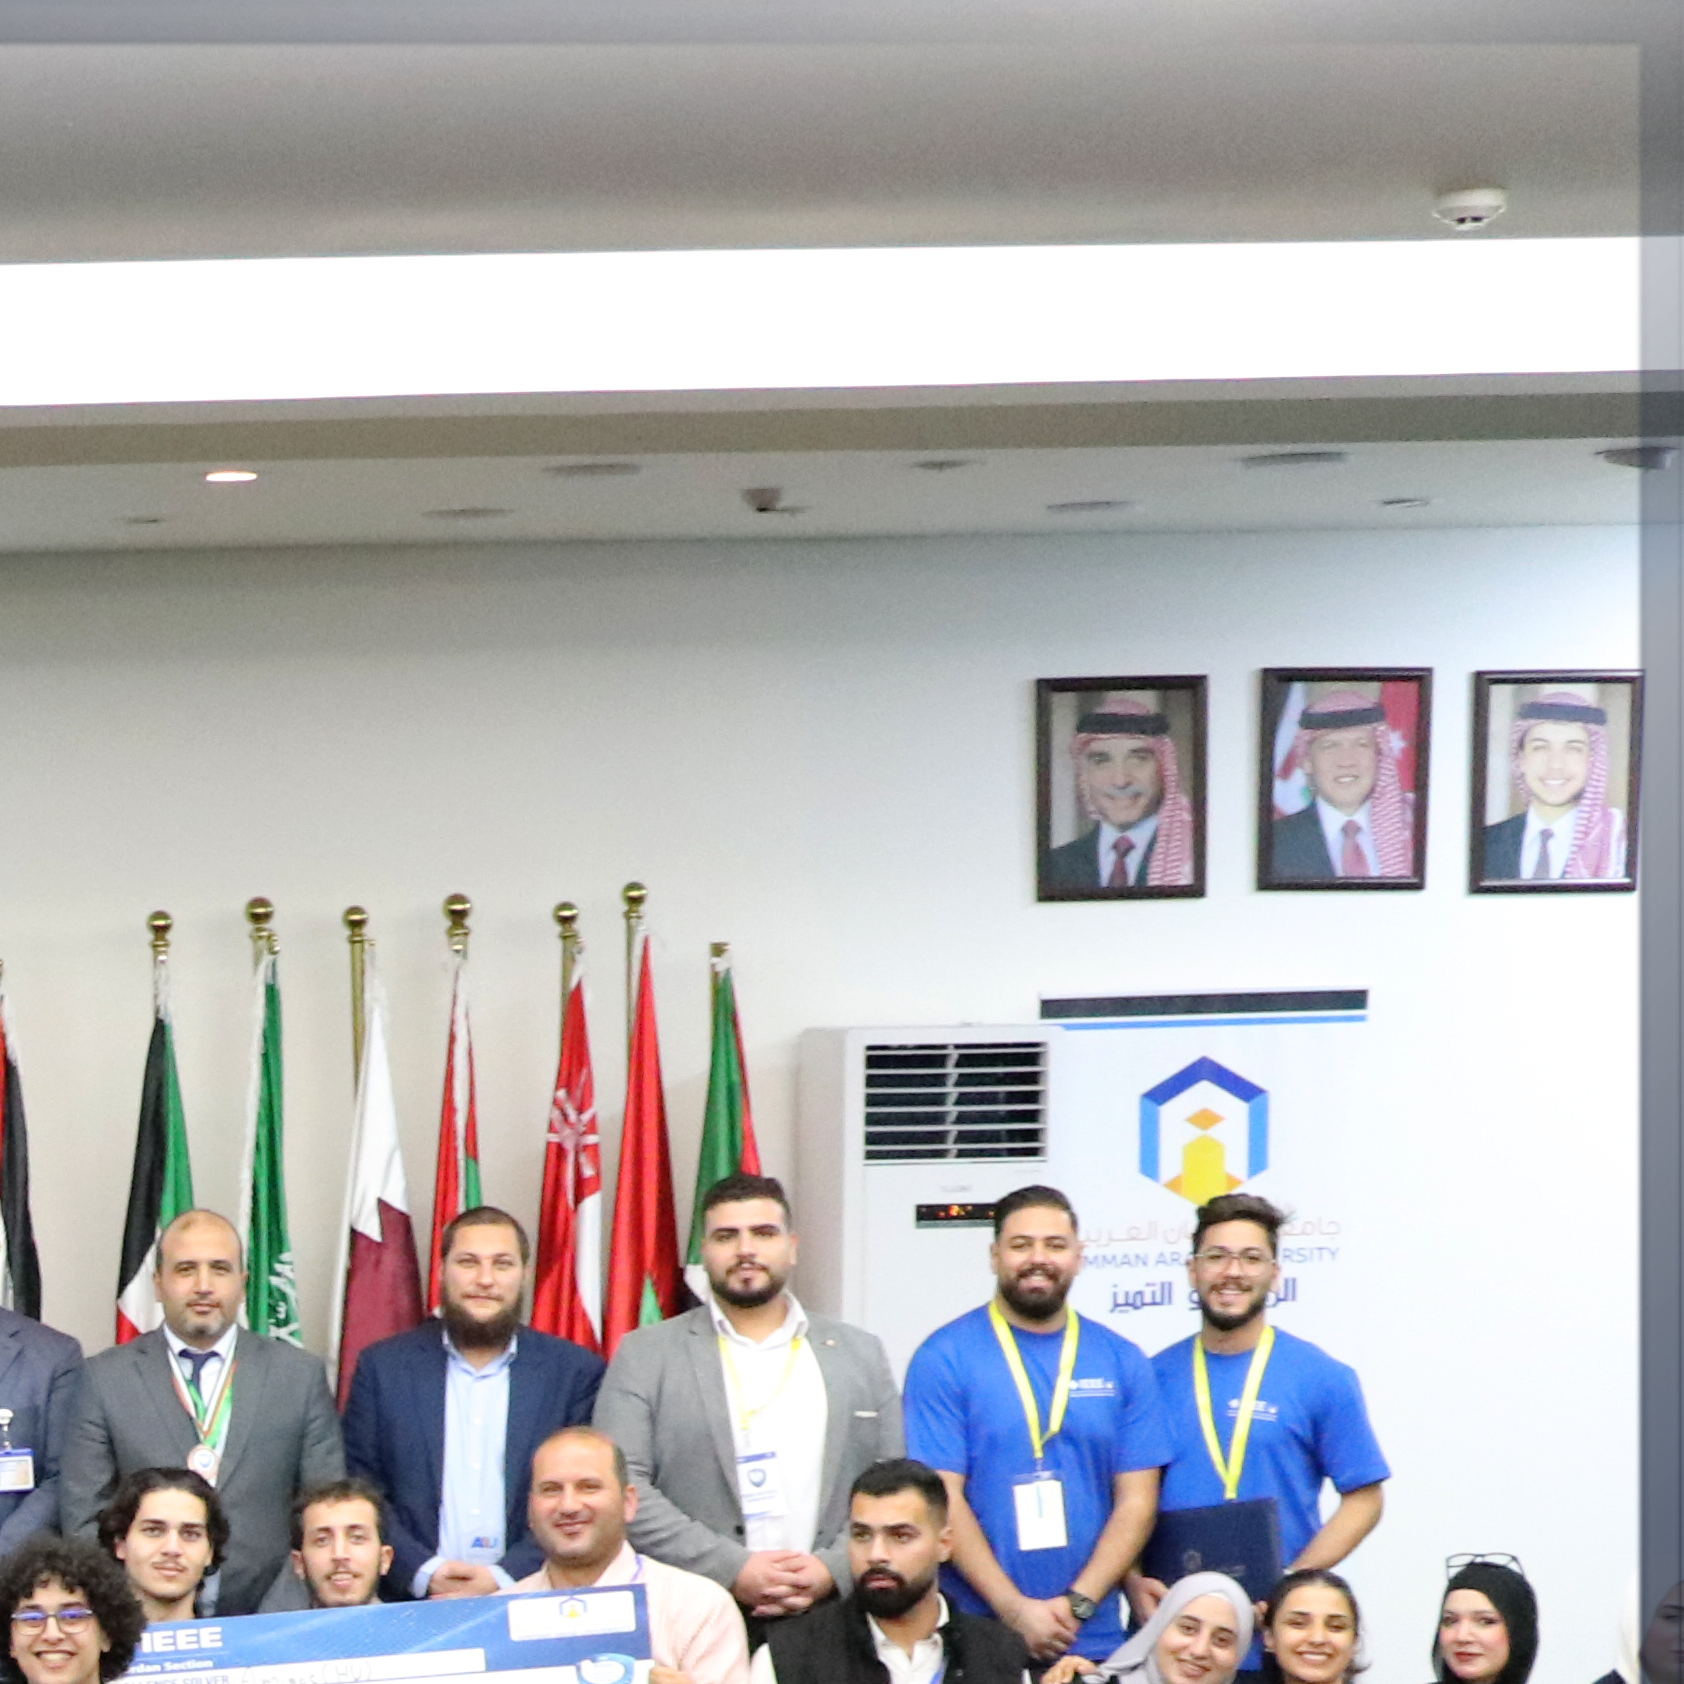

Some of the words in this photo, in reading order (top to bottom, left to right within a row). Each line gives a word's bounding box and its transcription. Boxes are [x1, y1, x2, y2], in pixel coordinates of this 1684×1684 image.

[1082, 1252, 1148, 1269] MMAN
[1109, 1281, 1173, 1313] التميز
[140, 1624, 224, 1653] IEEE
[163, 1657, 214, 1672] Section
